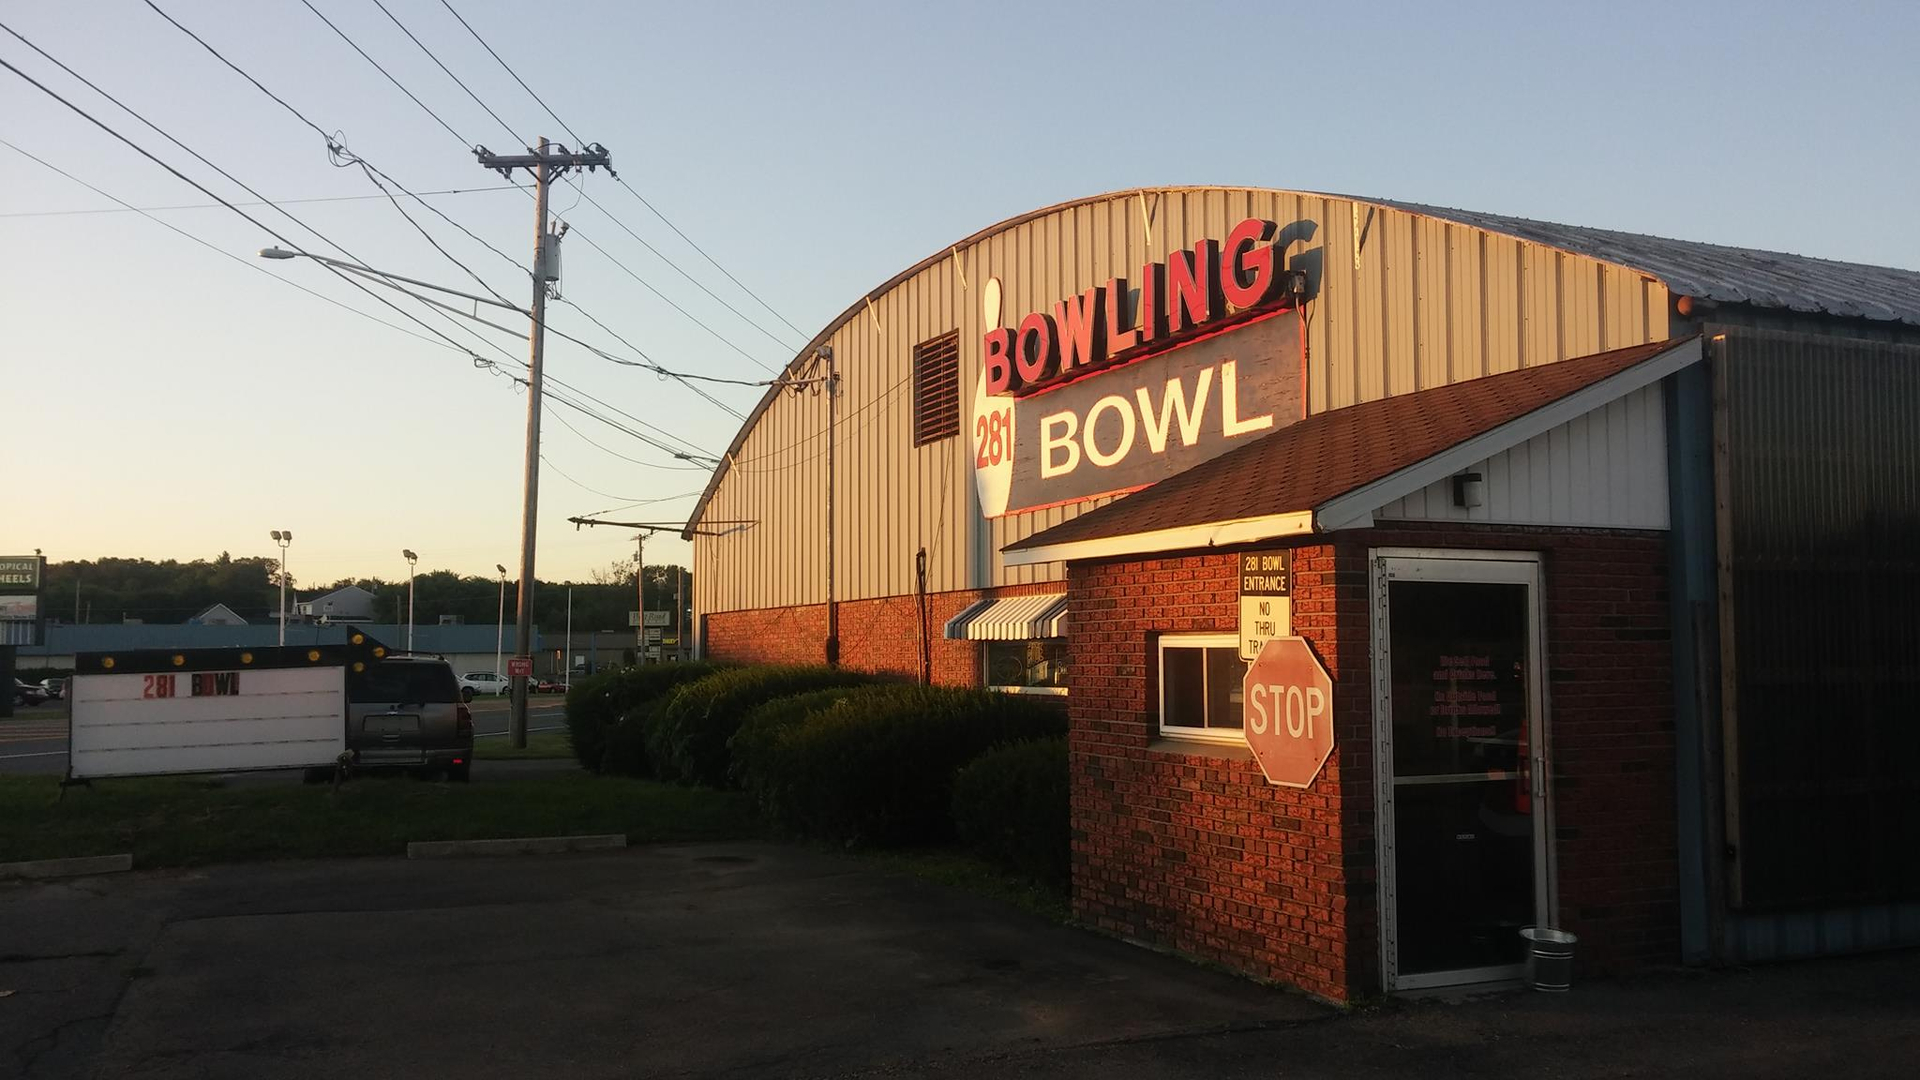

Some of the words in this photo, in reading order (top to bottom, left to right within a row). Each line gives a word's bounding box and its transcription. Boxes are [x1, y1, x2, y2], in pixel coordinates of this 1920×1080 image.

[984, 218, 1275, 397] BOWLING
[1041, 361, 1273, 479] BOWL
[977, 407, 1011, 469] 281
[1245, 556, 1259, 571] 281
[1262, 556, 1285, 571] BOWL
[1244, 576, 1286, 591] ENTRANCE
[1259, 601, 1271, 616] NO
[1254, 621, 1276, 636] THRU
[143, 675, 175, 699] 281
[191, 672, 240, 697] BOWL
[1250, 683, 1325, 739] STOP
